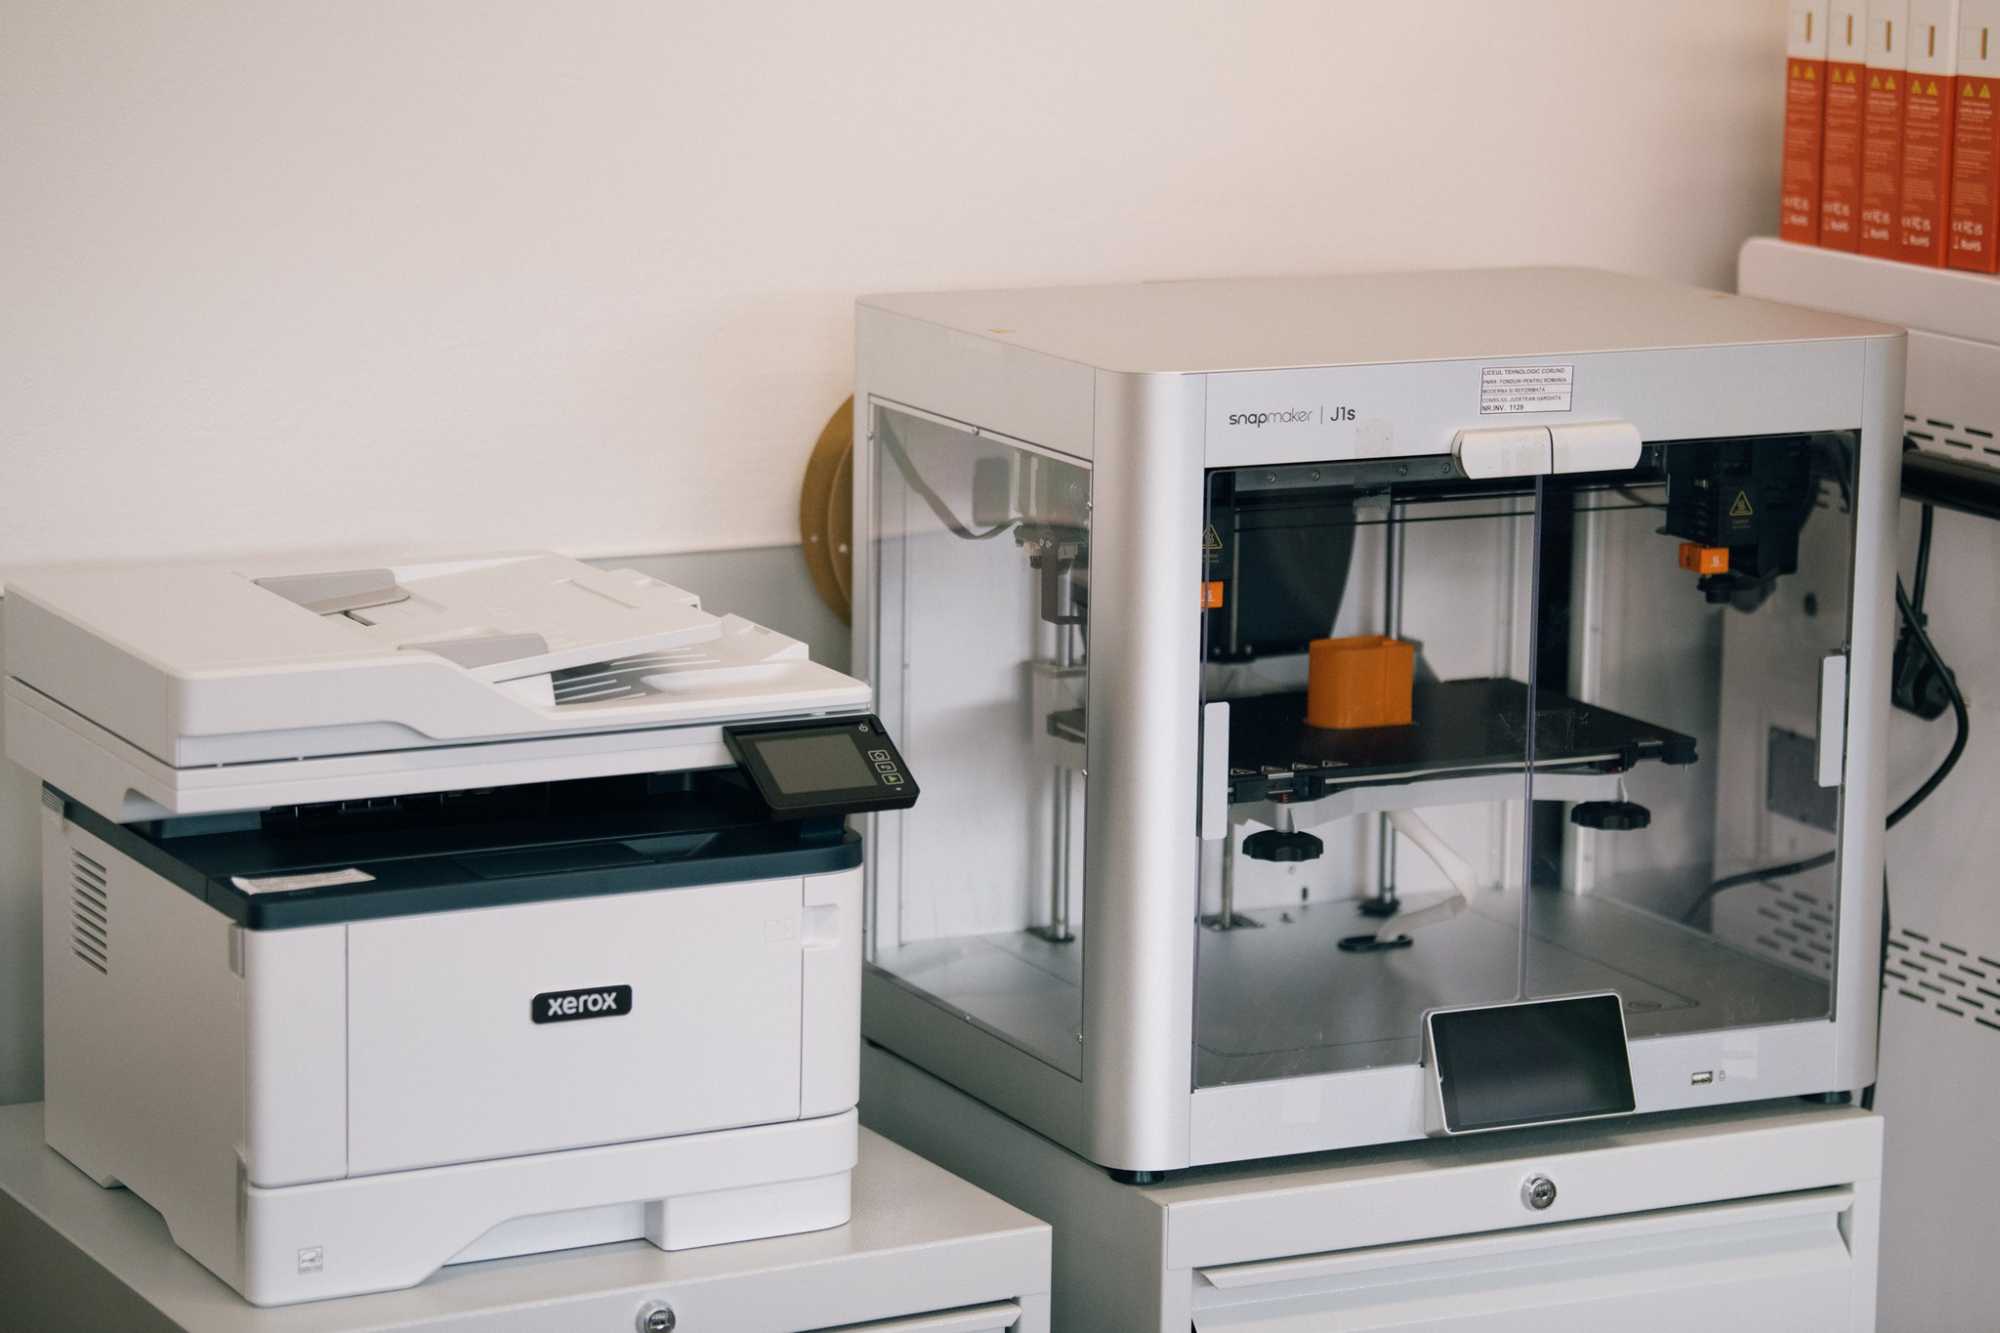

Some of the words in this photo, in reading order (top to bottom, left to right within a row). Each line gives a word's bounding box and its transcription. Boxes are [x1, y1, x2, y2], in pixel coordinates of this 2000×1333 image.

[1228, 407, 1313, 428] snapmaker
[1329, 406, 1356, 421] J1s
[547, 991, 617, 1017] xerox
